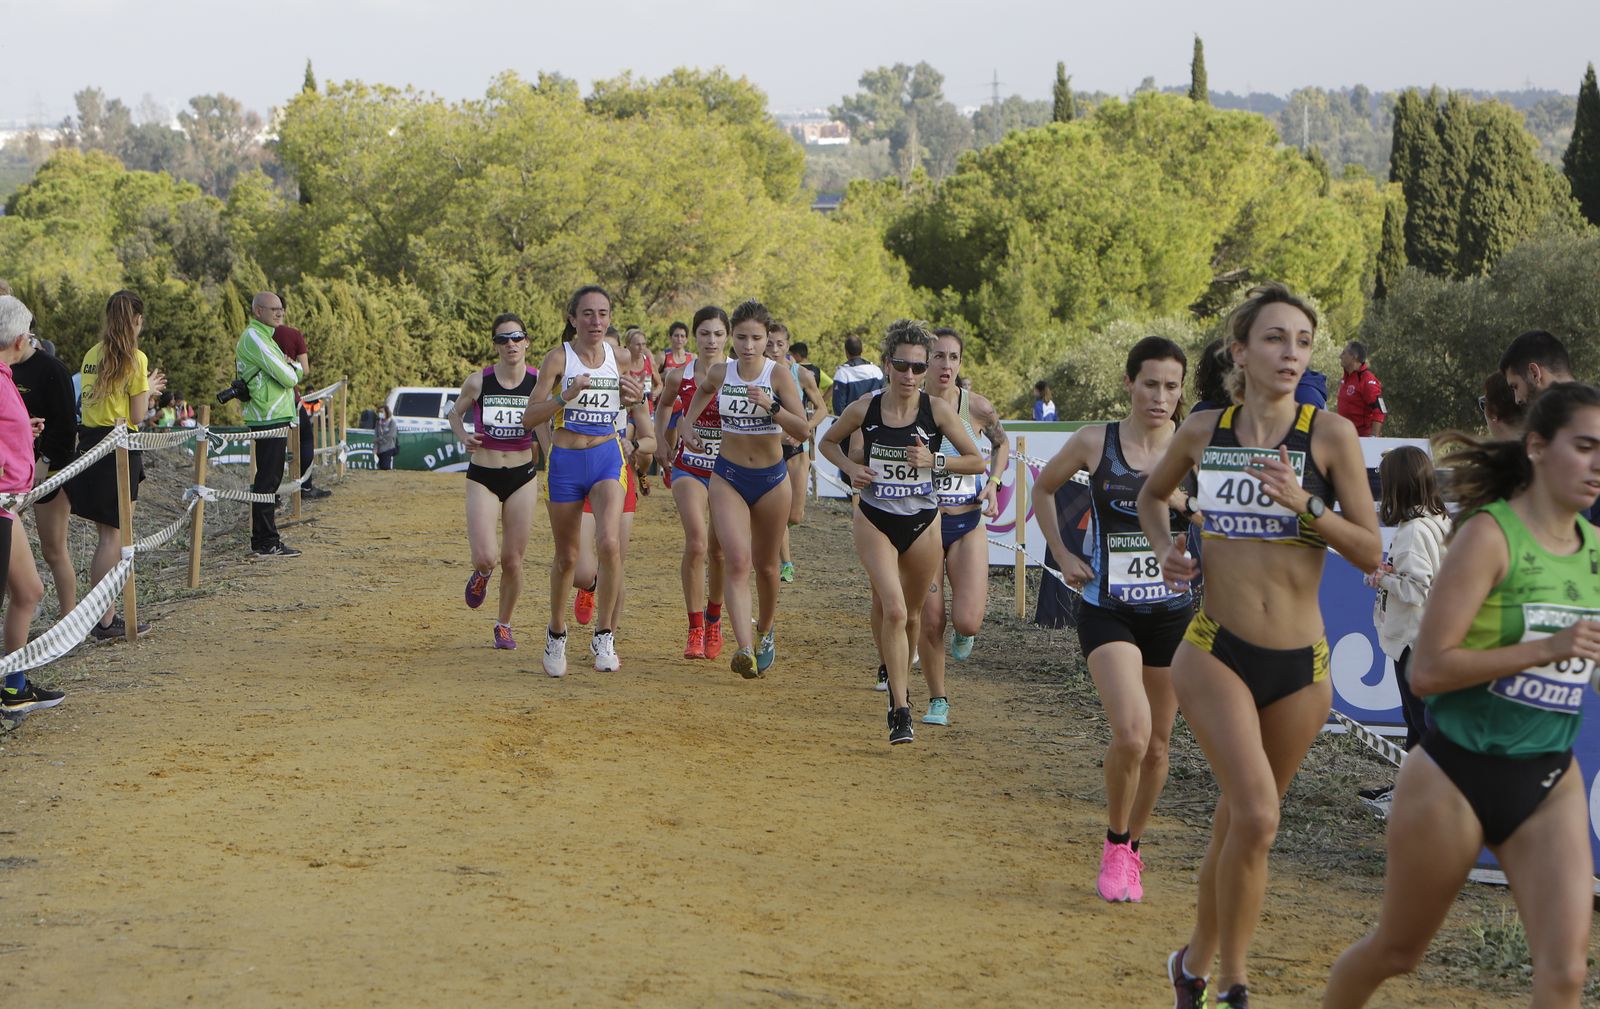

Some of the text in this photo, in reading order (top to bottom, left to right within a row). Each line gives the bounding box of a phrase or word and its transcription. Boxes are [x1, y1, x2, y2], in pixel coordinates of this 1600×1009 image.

[484, 397, 511, 405] DIPUTACION
[578, 393, 610, 408] 442
[728, 400, 758, 414] 427
[494, 410, 523, 424] 413
[570, 410, 613, 423] Joma
[704, 442, 720, 456] 63
[871, 448, 902, 458] DIPUTACION
[346, 461, 378, 470] SEVILL
[686, 456, 715, 469] Jom
[1202, 451, 1251, 467] DIPUTACION
[883, 464, 919, 480] 564
[875, 484, 924, 498] Joma
[1216, 478, 1274, 507] 408
[1110, 536, 1150, 548] DIPUTACIO
[1127, 557, 1160, 578] 48
[1119, 585, 1172, 601] Jom
[1505, 675, 1583, 706] Joma
